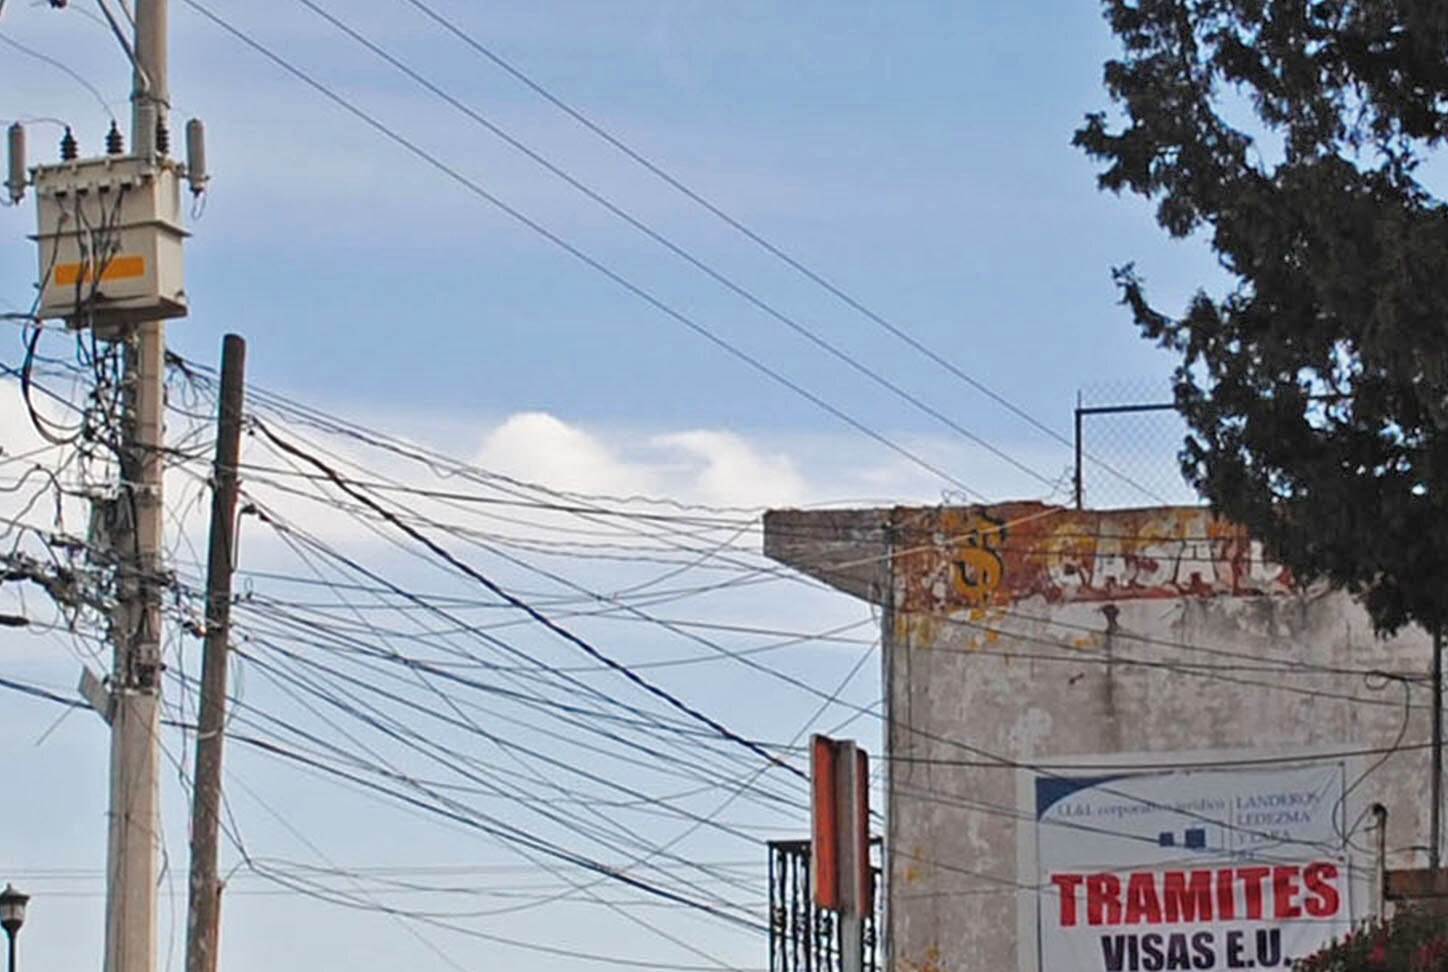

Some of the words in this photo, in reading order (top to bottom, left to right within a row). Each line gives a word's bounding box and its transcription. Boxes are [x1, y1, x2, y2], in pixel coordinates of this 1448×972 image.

[1051, 862, 1340, 927] TRAMITES
[1101, 931, 1214, 972] VISAS
[1226, 928, 1292, 970] E.U.
